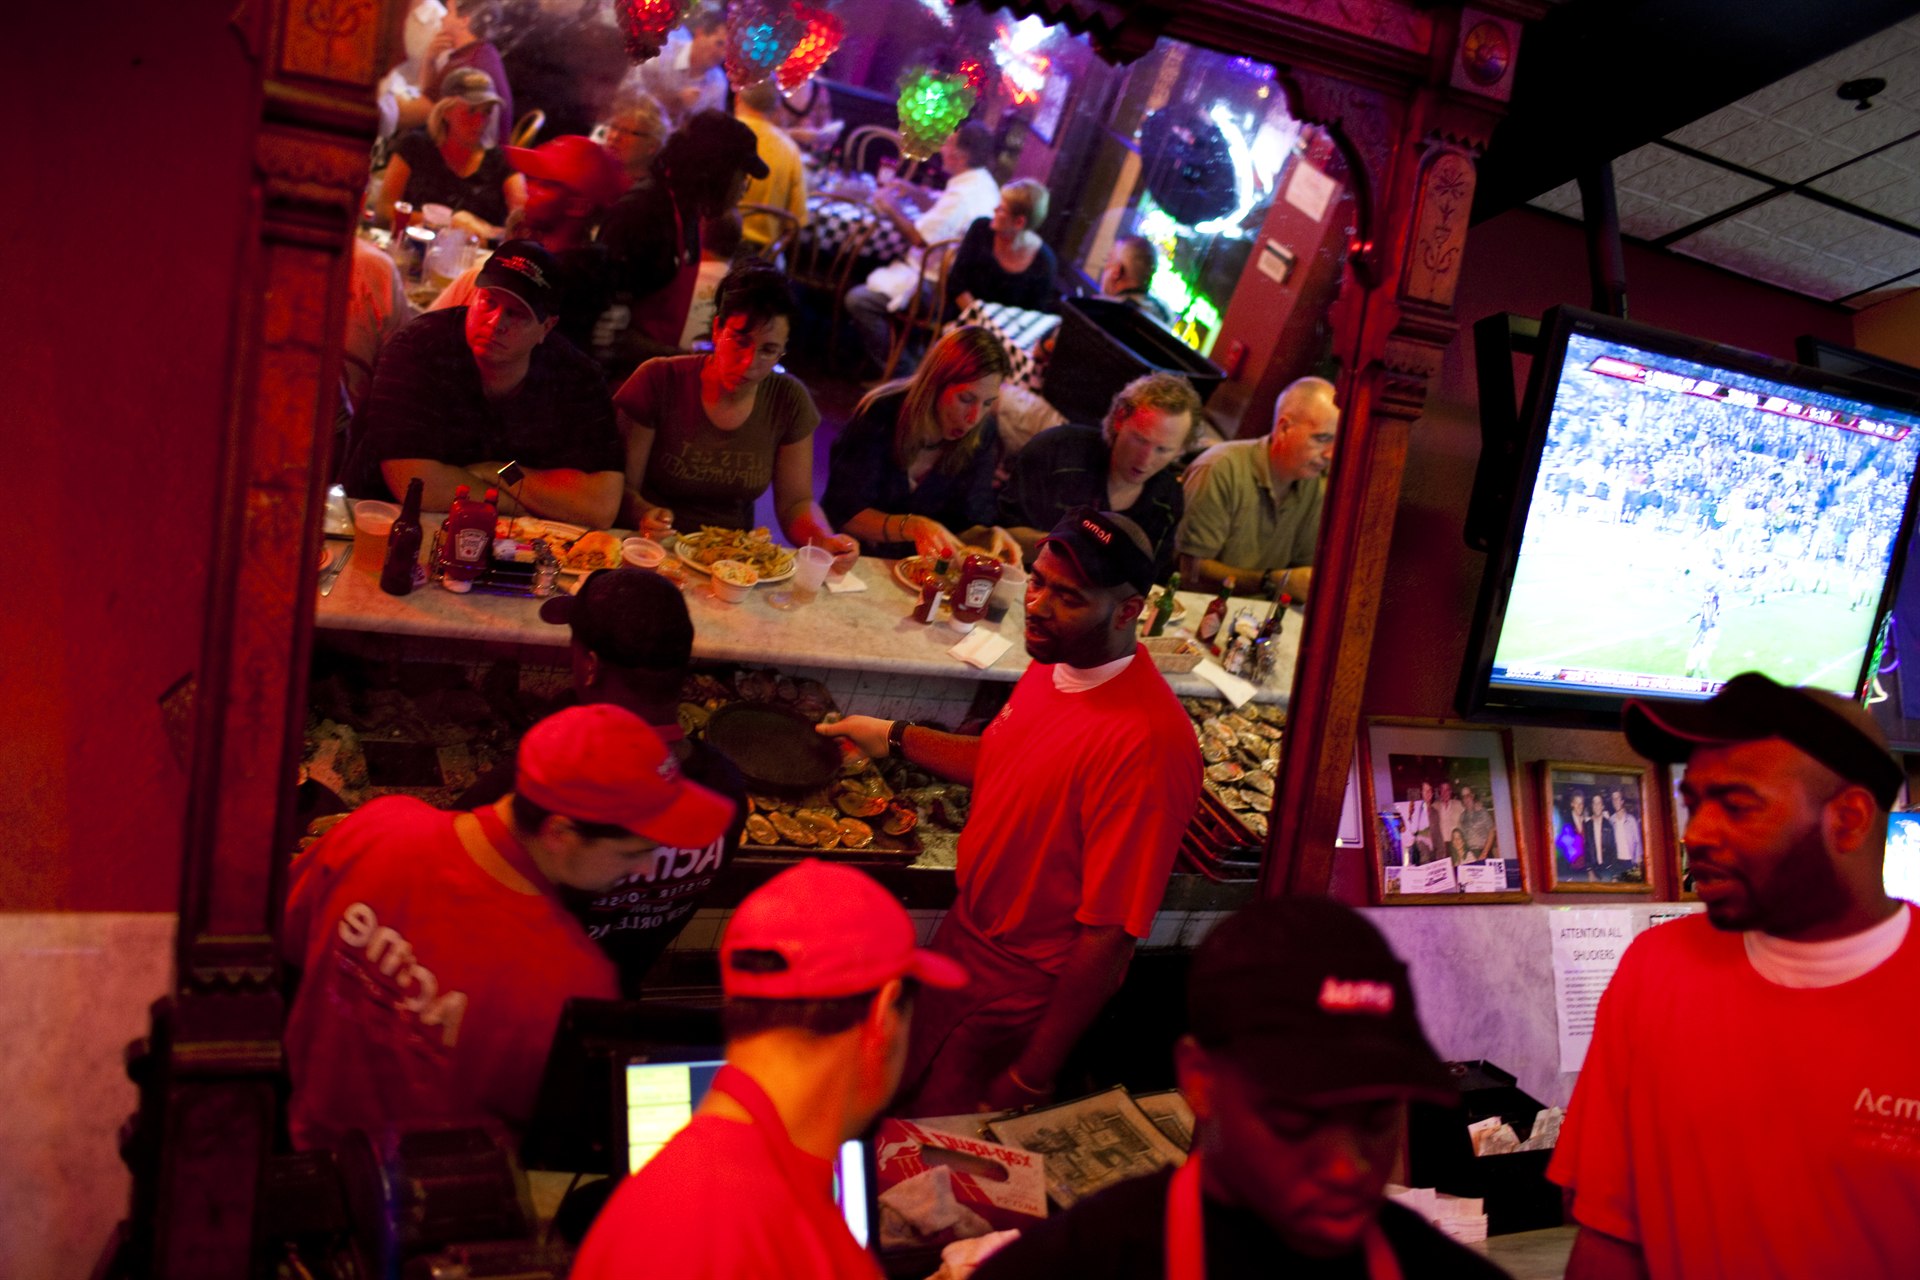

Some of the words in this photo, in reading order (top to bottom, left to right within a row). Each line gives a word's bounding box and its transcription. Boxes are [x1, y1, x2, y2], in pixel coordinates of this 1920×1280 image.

[1560, 927, 1606, 939] ATTENTION
[1607, 928, 1623, 938] ALL
[1573, 949, 1615, 961] SHUCKERS
